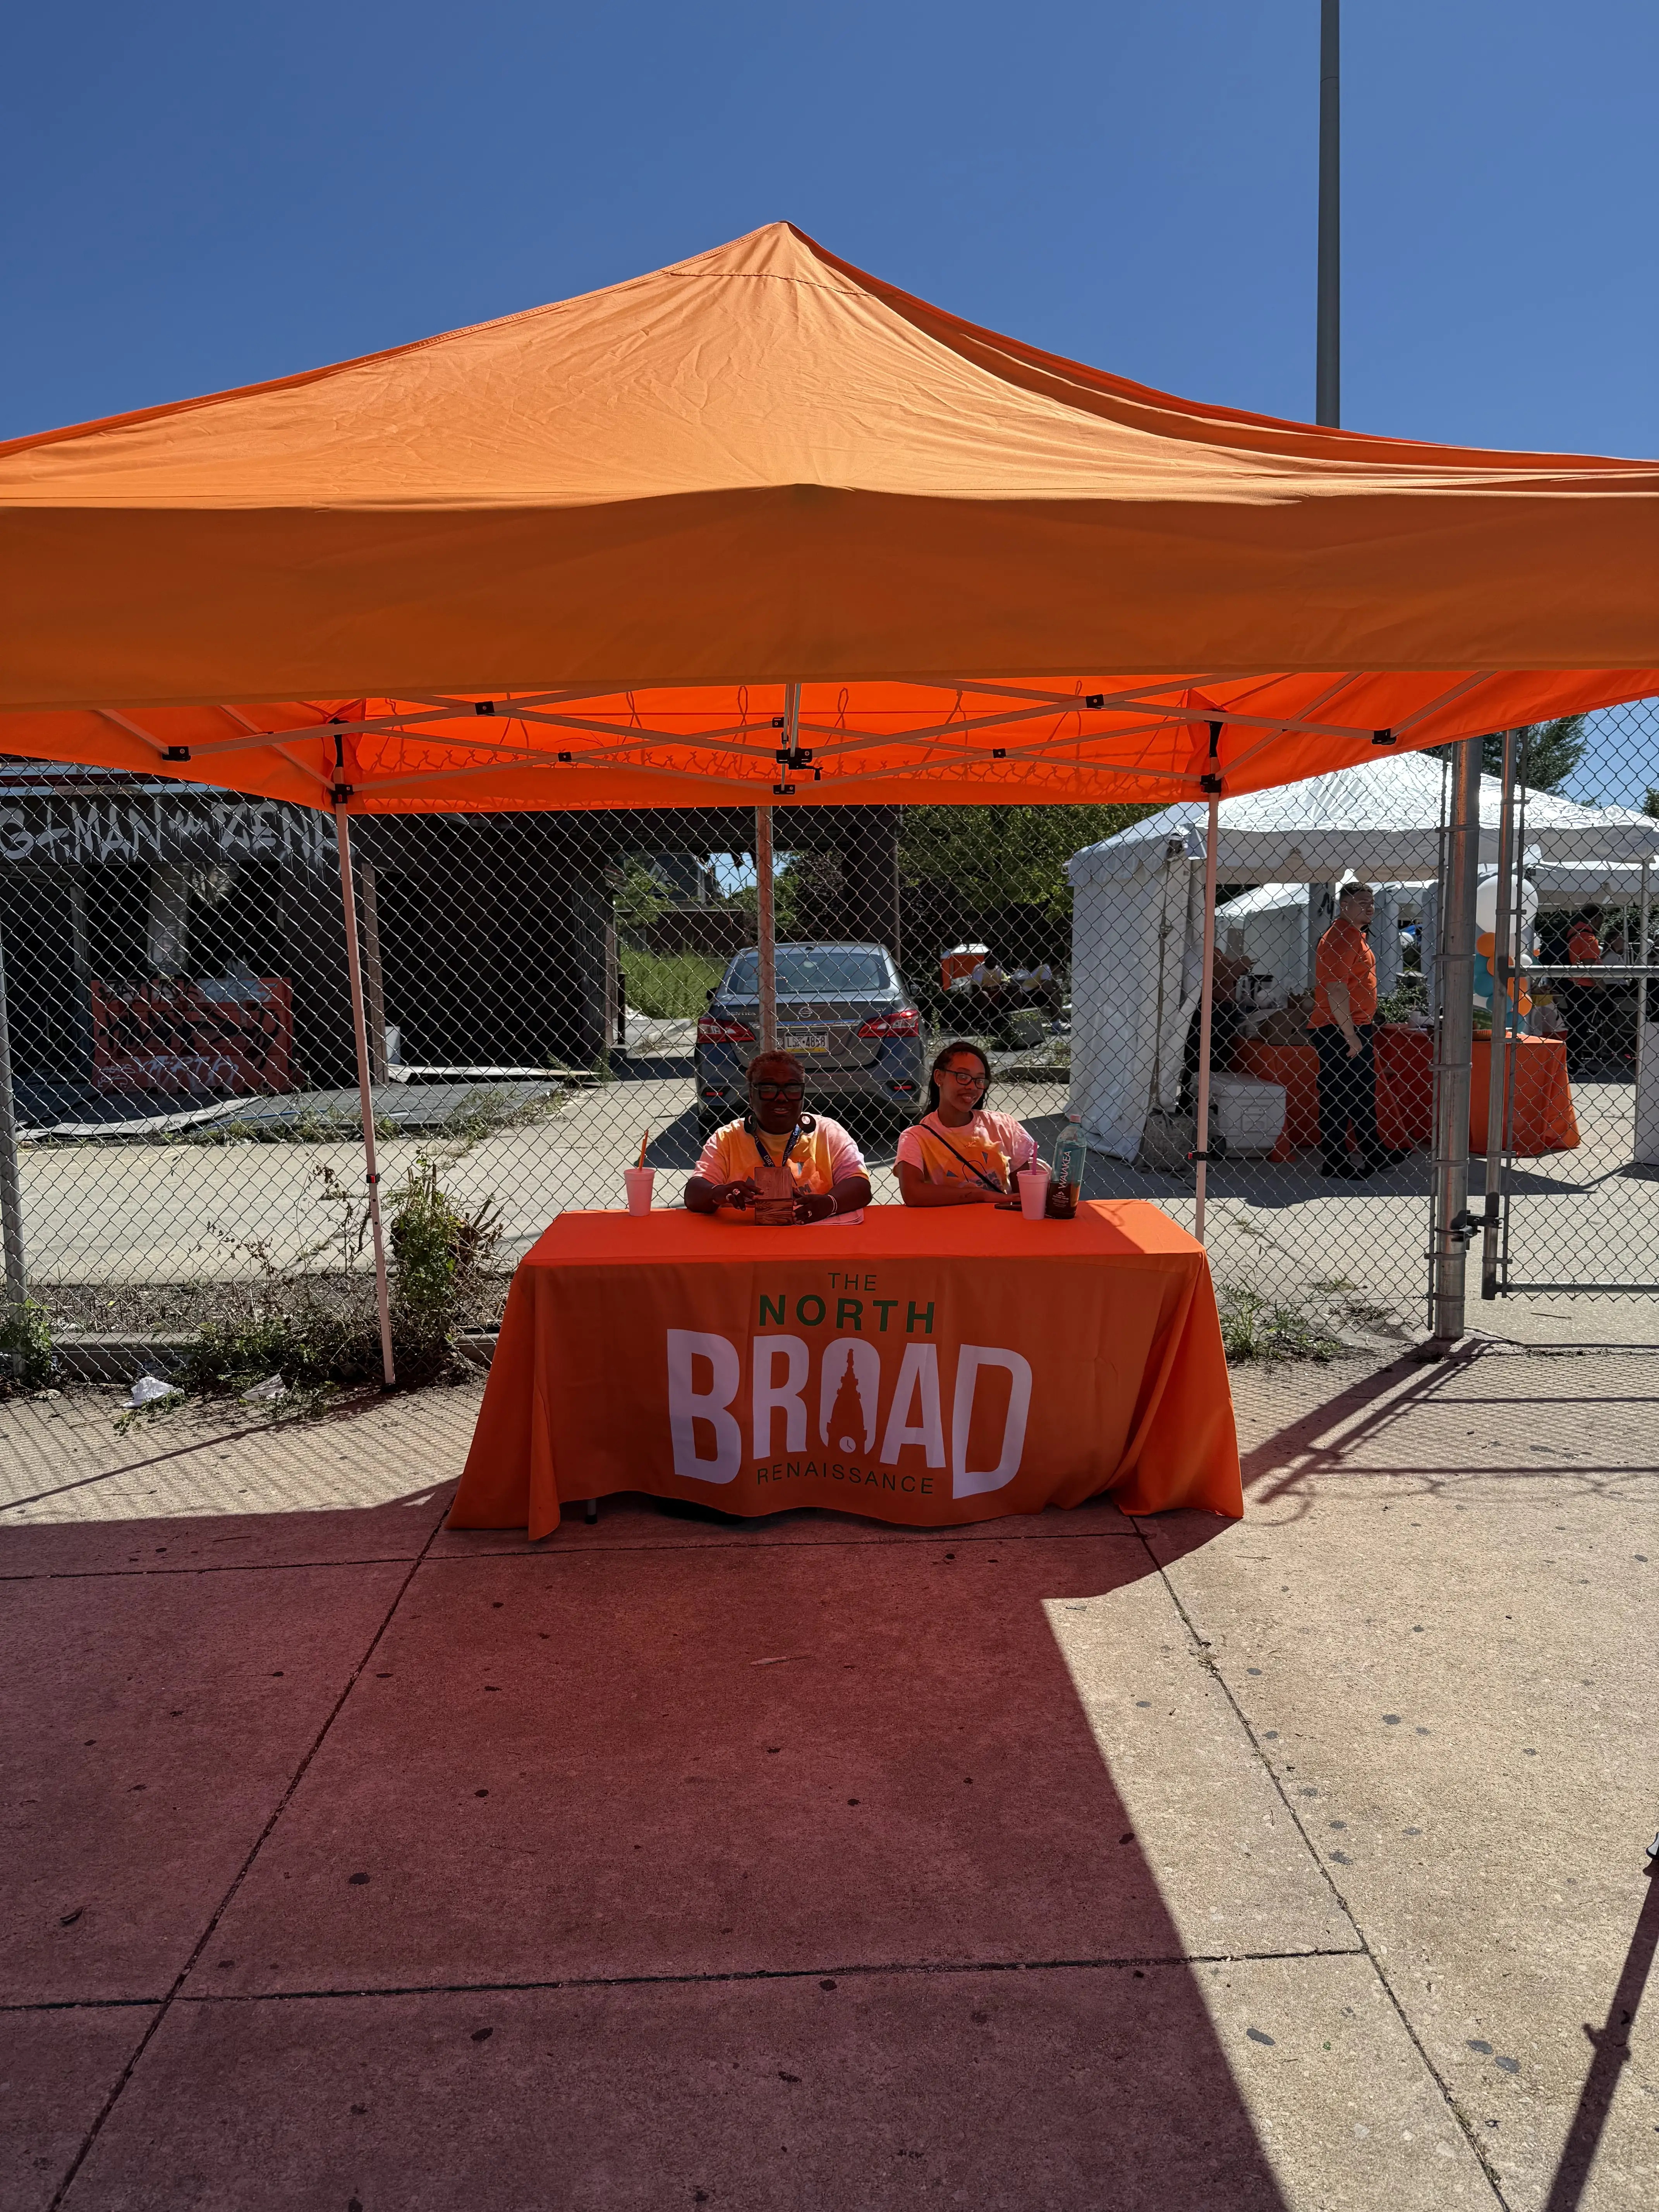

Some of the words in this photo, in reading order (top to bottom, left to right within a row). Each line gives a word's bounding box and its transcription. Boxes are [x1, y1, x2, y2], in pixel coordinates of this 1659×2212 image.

[1058, 1151, 1072, 1188] WAIAKEA
[828, 1273, 877, 1291] THE
[759, 1294, 935, 1334] NORTH
[667, 1328, 1032, 1499] BROAD
[757, 1462, 934, 1494] RENAISSANCE
